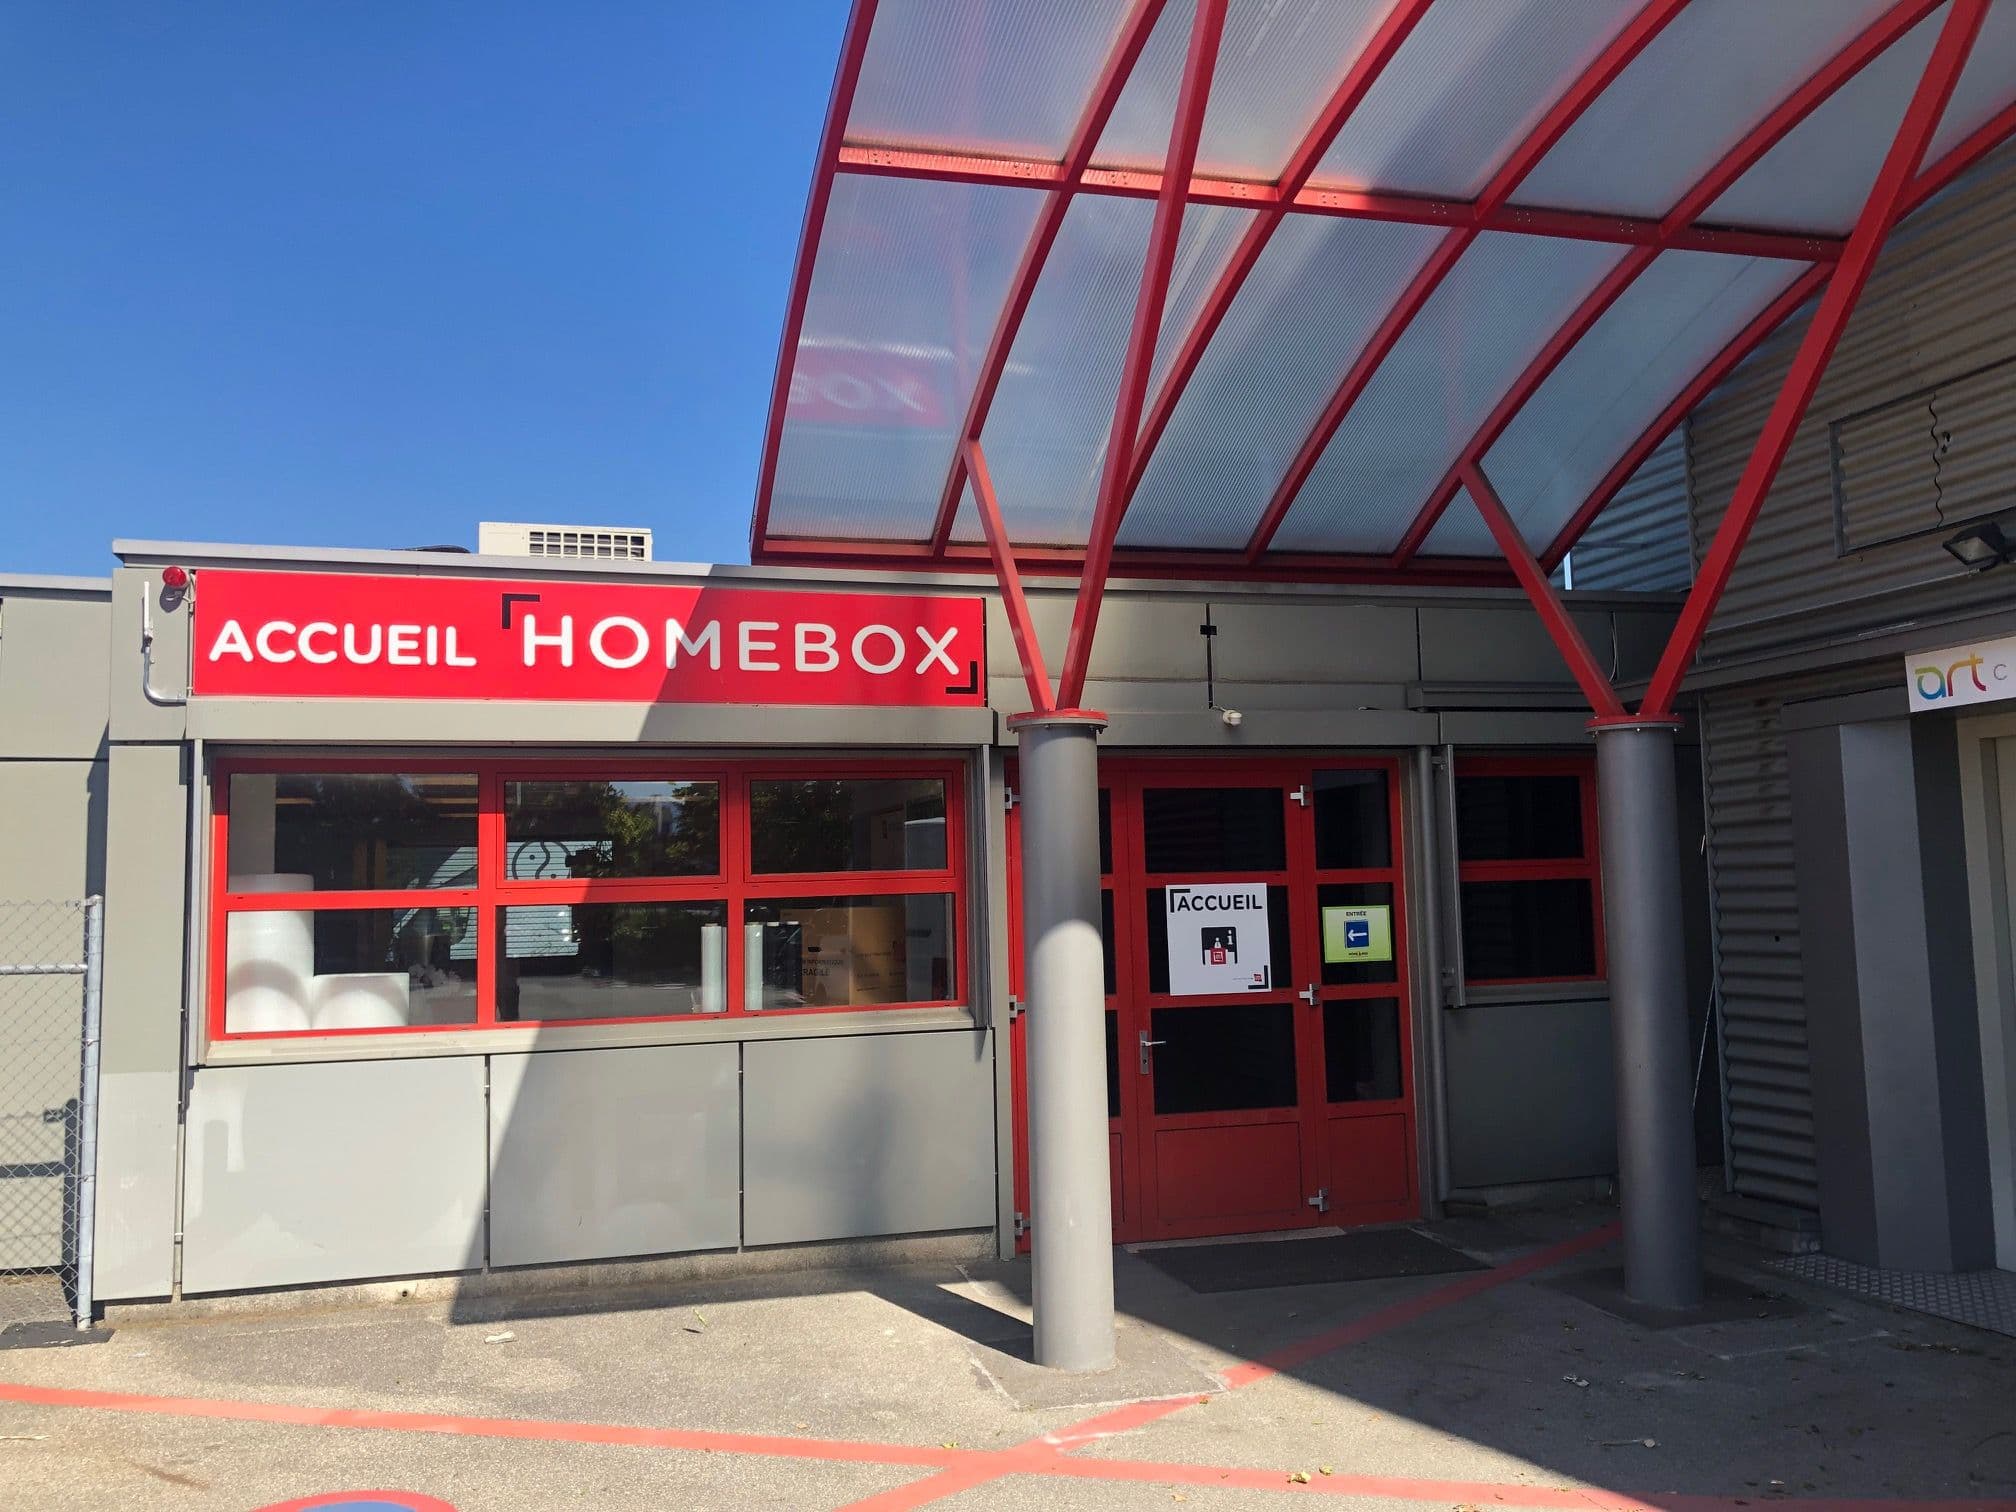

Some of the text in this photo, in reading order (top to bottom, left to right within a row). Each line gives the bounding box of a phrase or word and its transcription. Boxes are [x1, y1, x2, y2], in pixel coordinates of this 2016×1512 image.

[208, 613, 960, 675] ACCUEIL HOMEBOX
[1914, 651, 1987, 700] art
[1177, 894, 1263, 912] ACCUEIL
